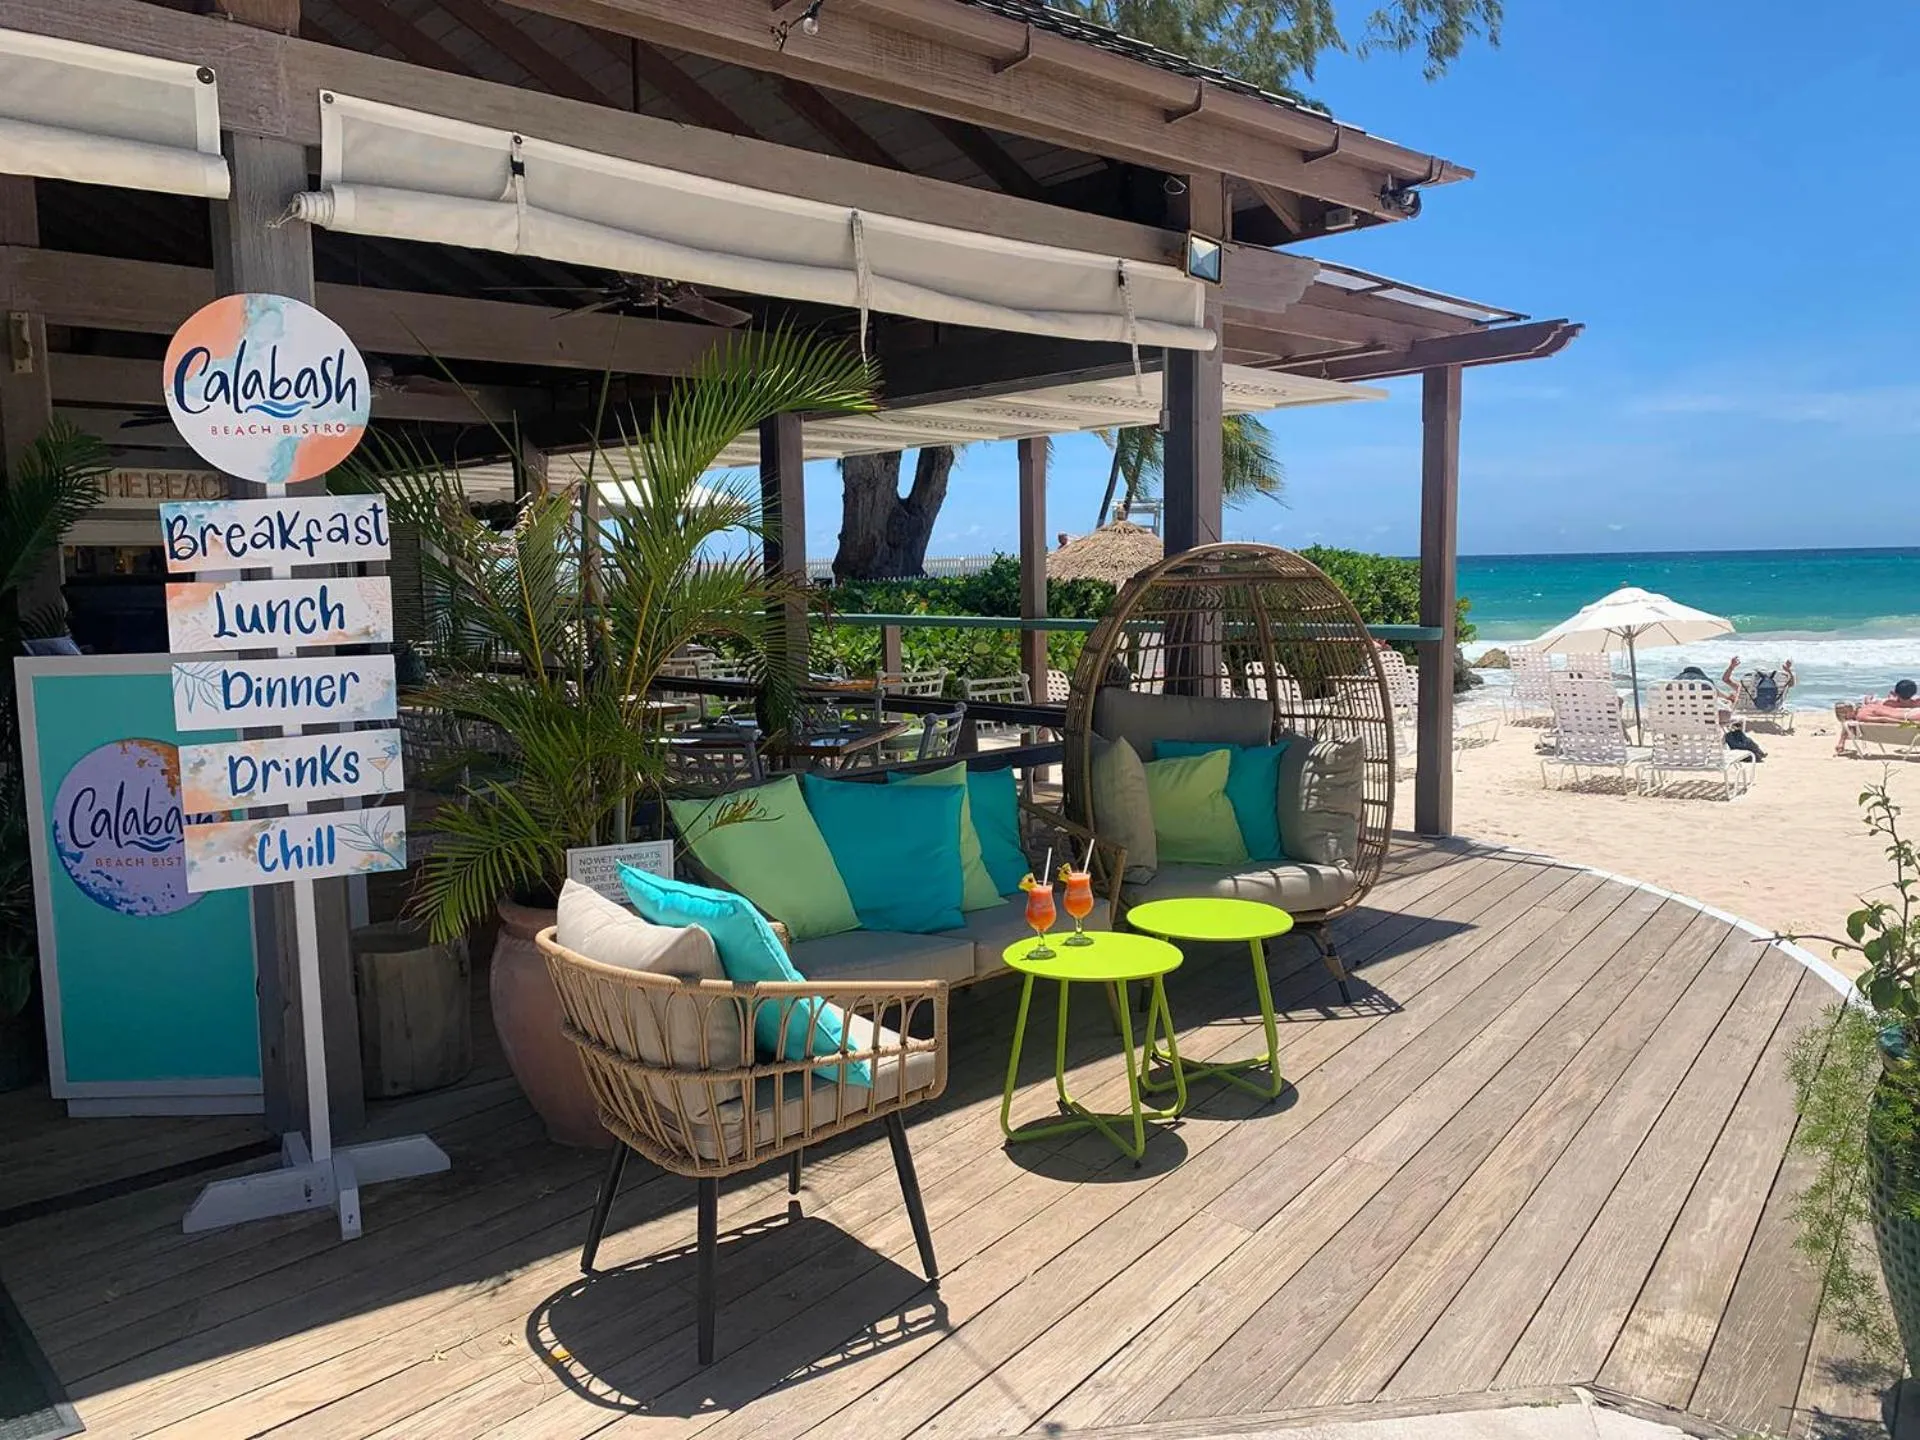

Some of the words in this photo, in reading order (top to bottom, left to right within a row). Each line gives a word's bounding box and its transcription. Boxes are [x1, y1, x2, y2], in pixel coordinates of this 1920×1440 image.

[173, 339, 358, 415] Calabash
[210, 423, 272, 436] BEACH
[282, 422, 347, 435] BISTRO
[165, 502, 390, 561] Breakfast
[213, 585, 346, 639] Lunch
[221, 670, 360, 711] Dinner
[227, 744, 360, 796] Drinks
[67, 782, 214, 850] Calaba
[95, 857, 145, 868] BEACH
[151, 856, 183, 868] BIST
[257, 824, 336, 873] Chill
[579, 857, 592, 867] NO
[593, 855, 612, 864] WET
[579, 866, 599, 874] WET
